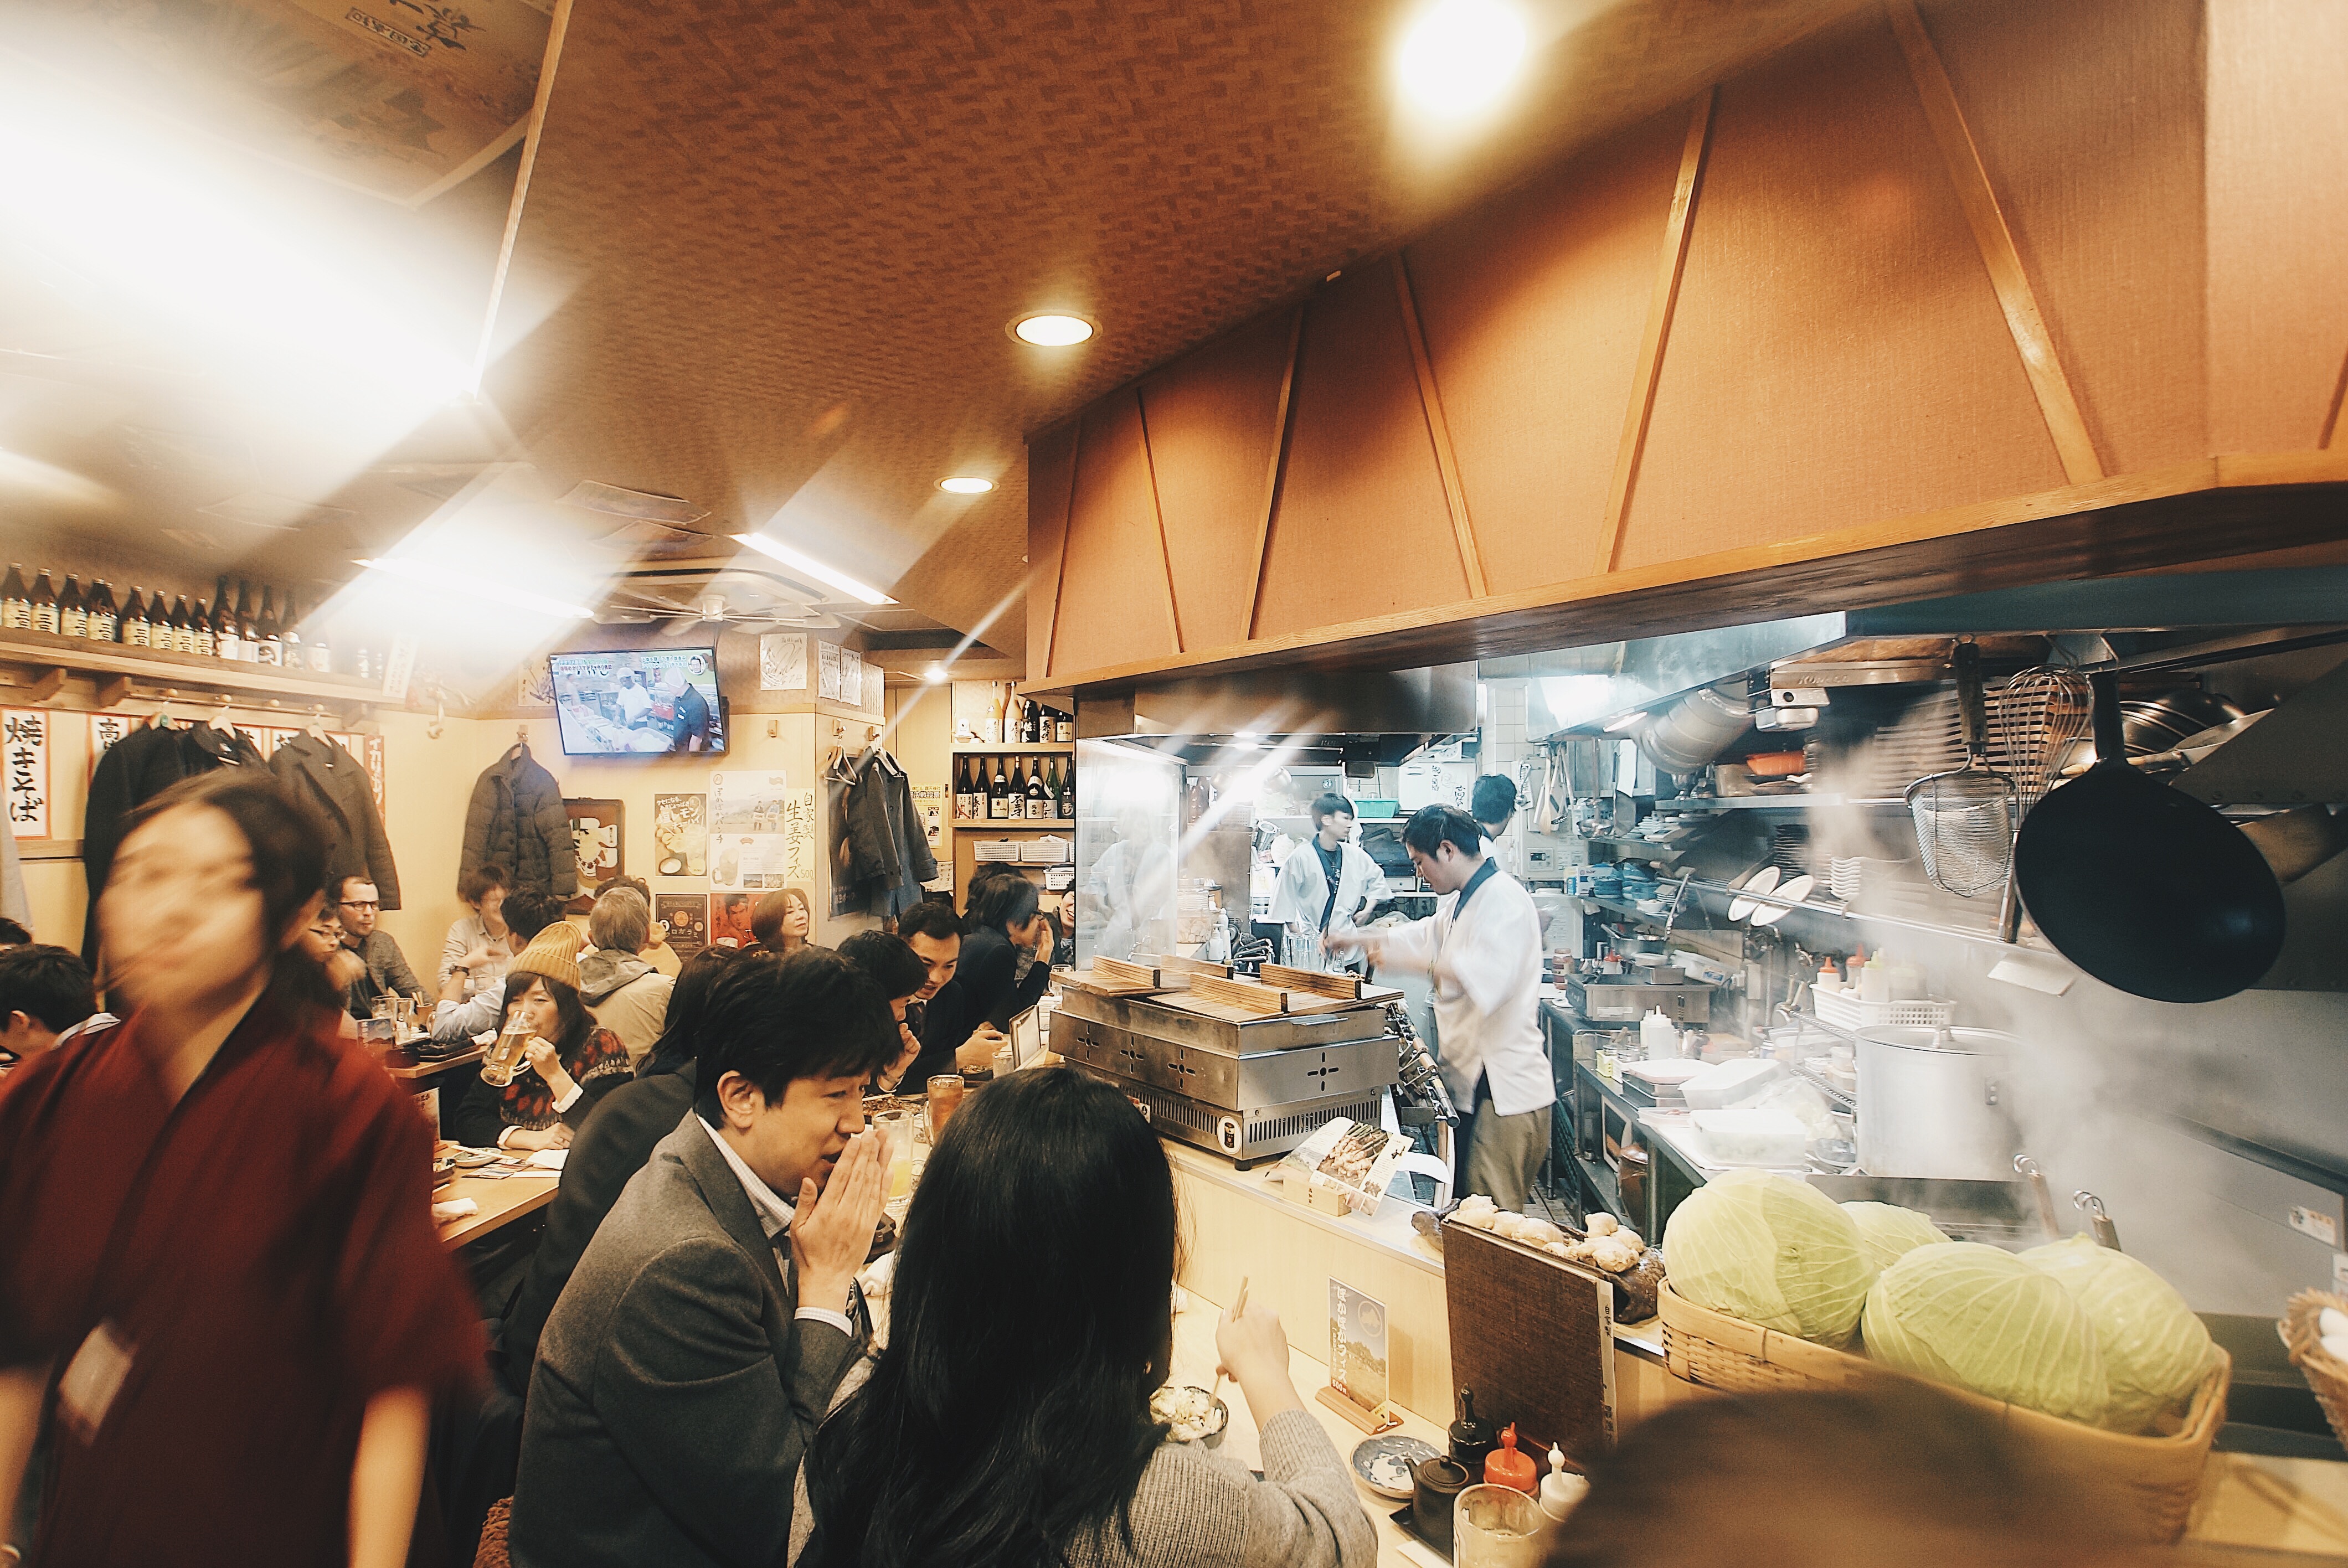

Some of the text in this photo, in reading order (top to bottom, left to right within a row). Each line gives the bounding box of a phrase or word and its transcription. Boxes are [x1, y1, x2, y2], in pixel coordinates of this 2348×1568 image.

[99, 718, 119, 750] 高
[4, 715, 44, 822] 焼きそば
[672, 815, 700, 829] チューハイ
[804, 792, 814, 839] 自家製
[785, 800, 803, 879] 生姜フィズ
